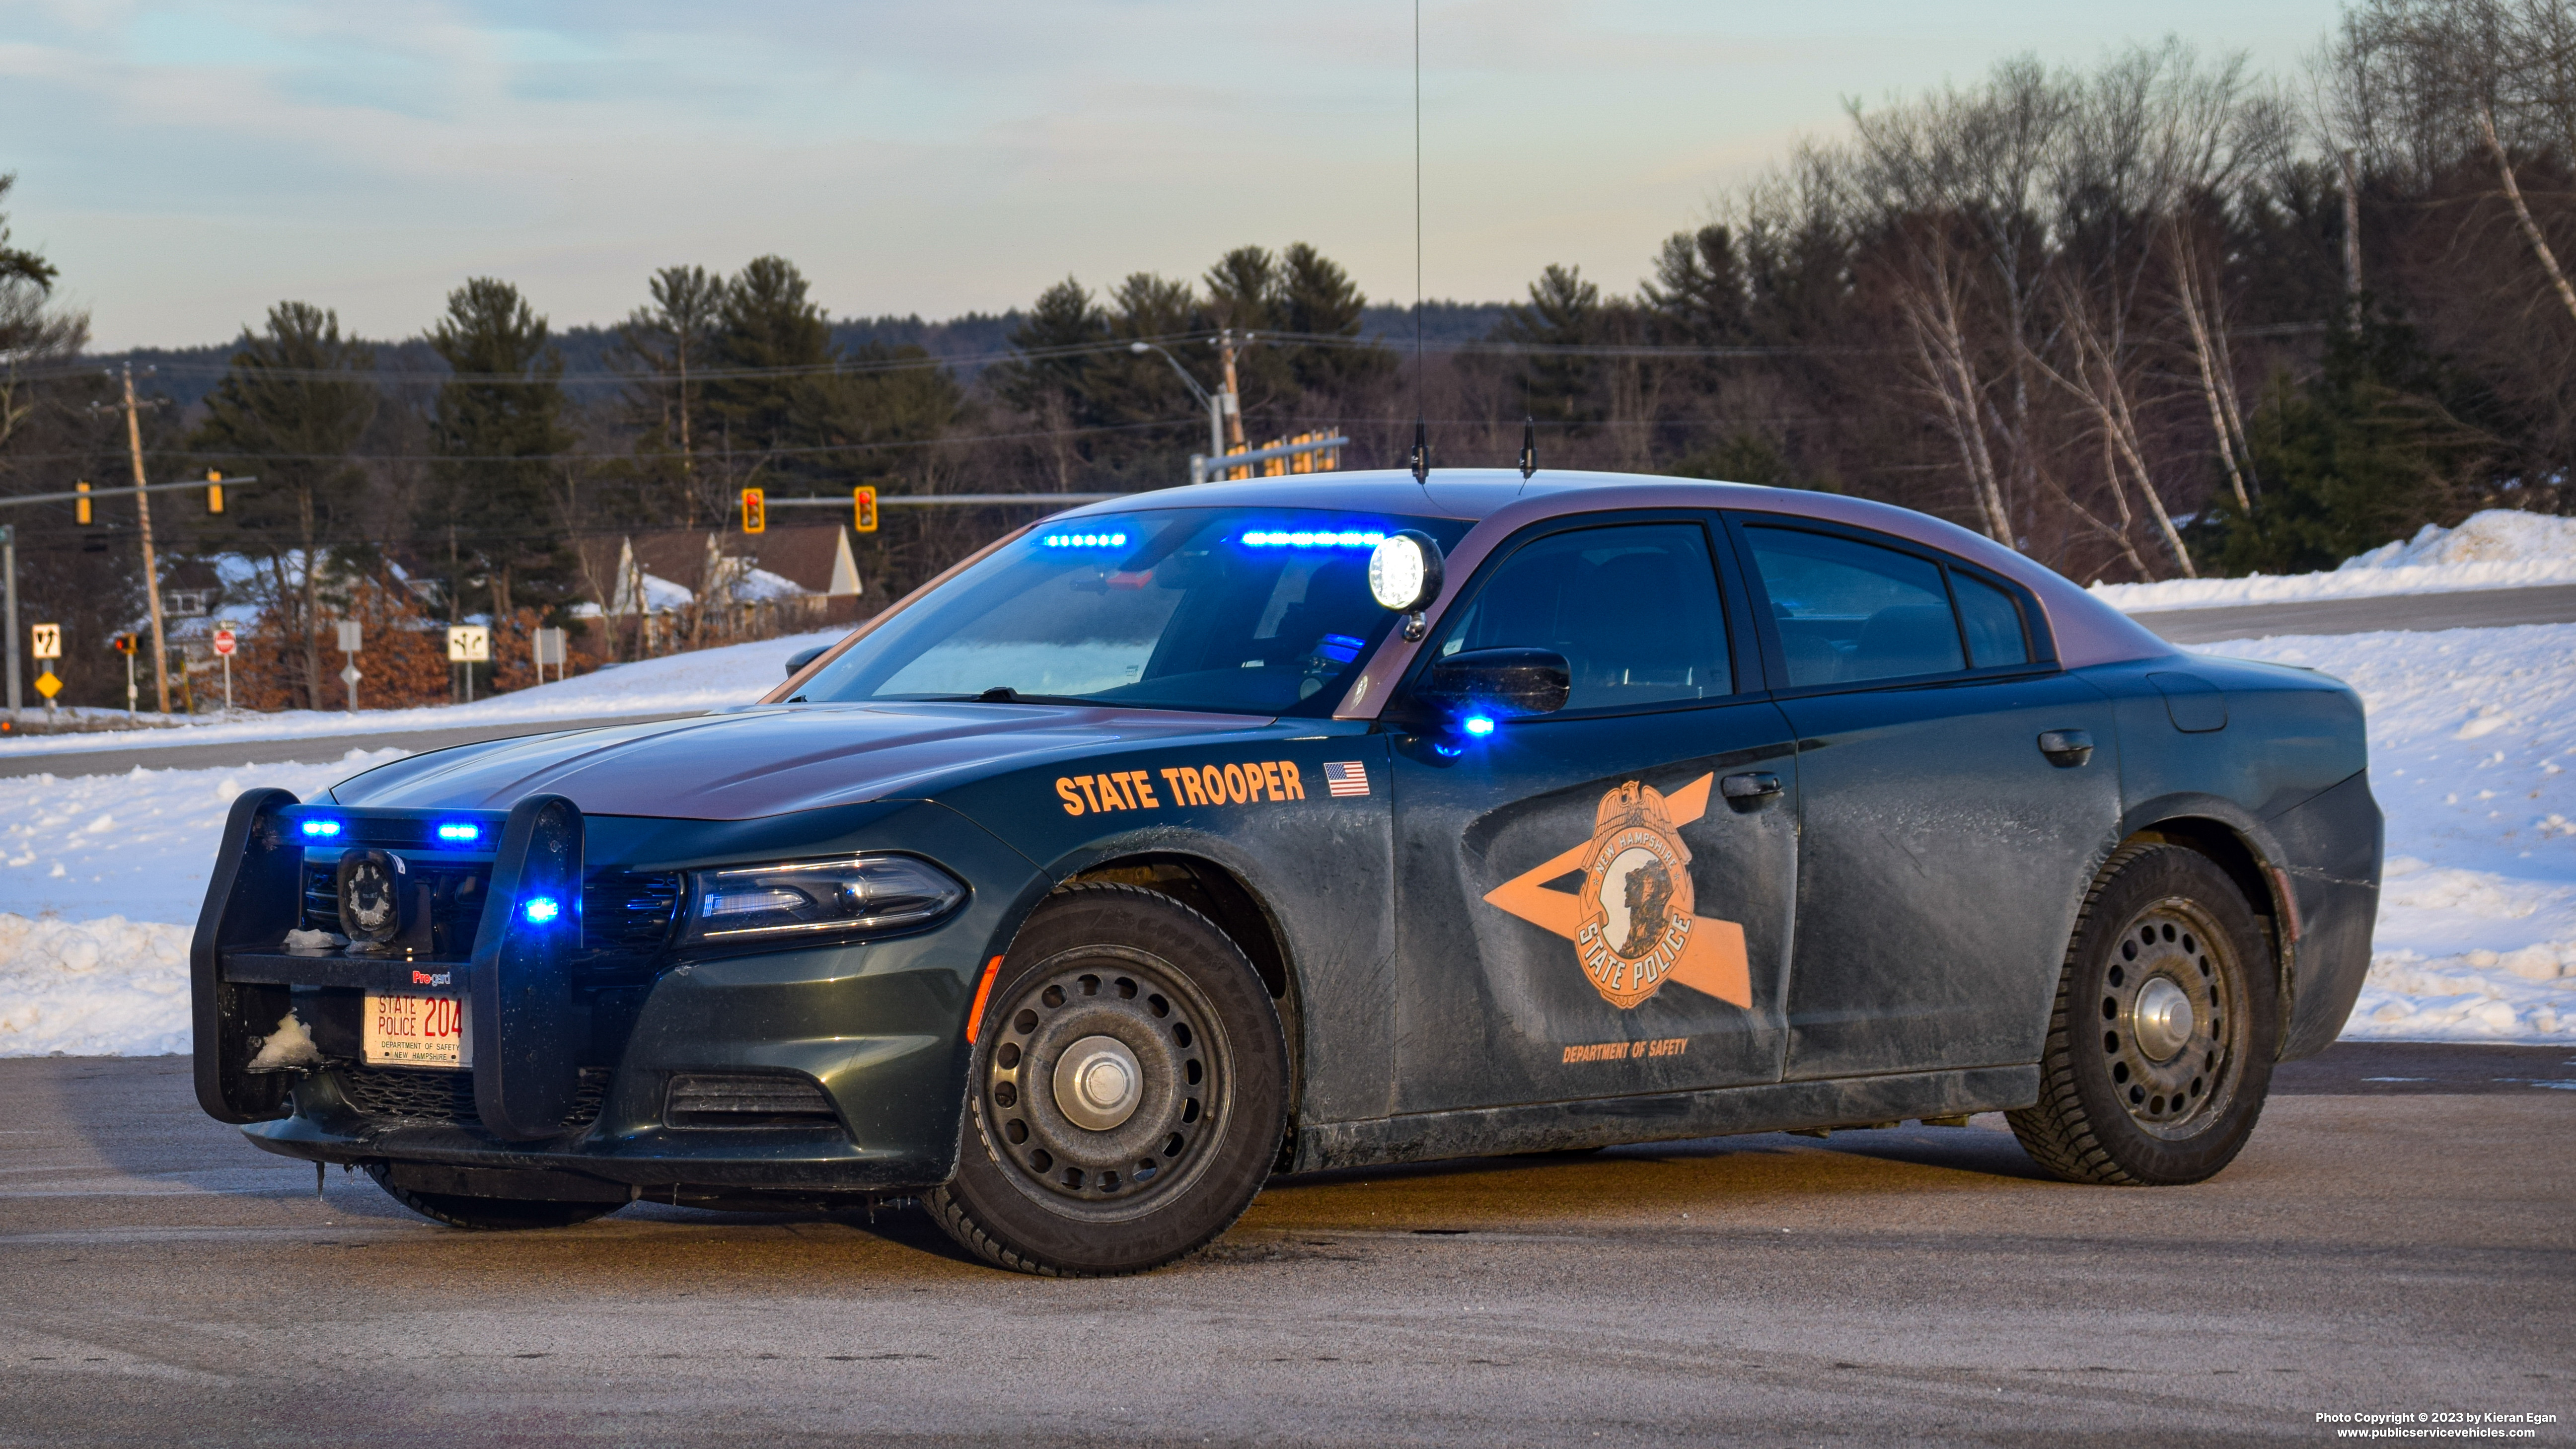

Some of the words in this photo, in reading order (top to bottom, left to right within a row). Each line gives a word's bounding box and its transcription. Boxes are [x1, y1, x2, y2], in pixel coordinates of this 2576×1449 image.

[1056, 771, 1159, 815] STATE
[1161, 761, 1305, 805] TROOPER
[1596, 844, 1615, 874] NEW
[1619, 832, 1678, 869] HAMPSHIRE
[1579, 922, 1626, 989] STATE
[1633, 913, 1691, 990] POLICE
[378, 1016, 416, 1036] POLICE
[379, 995, 417, 1014] STATE
[425, 997, 463, 1038] 204
[381, 1041, 421, 1049] DEPARTMENT
[1563, 1042, 1629, 1063] DEPARTMENT
[1632, 1041, 1647, 1058] OF
[1648, 1038, 1688, 1057] SAFETY
